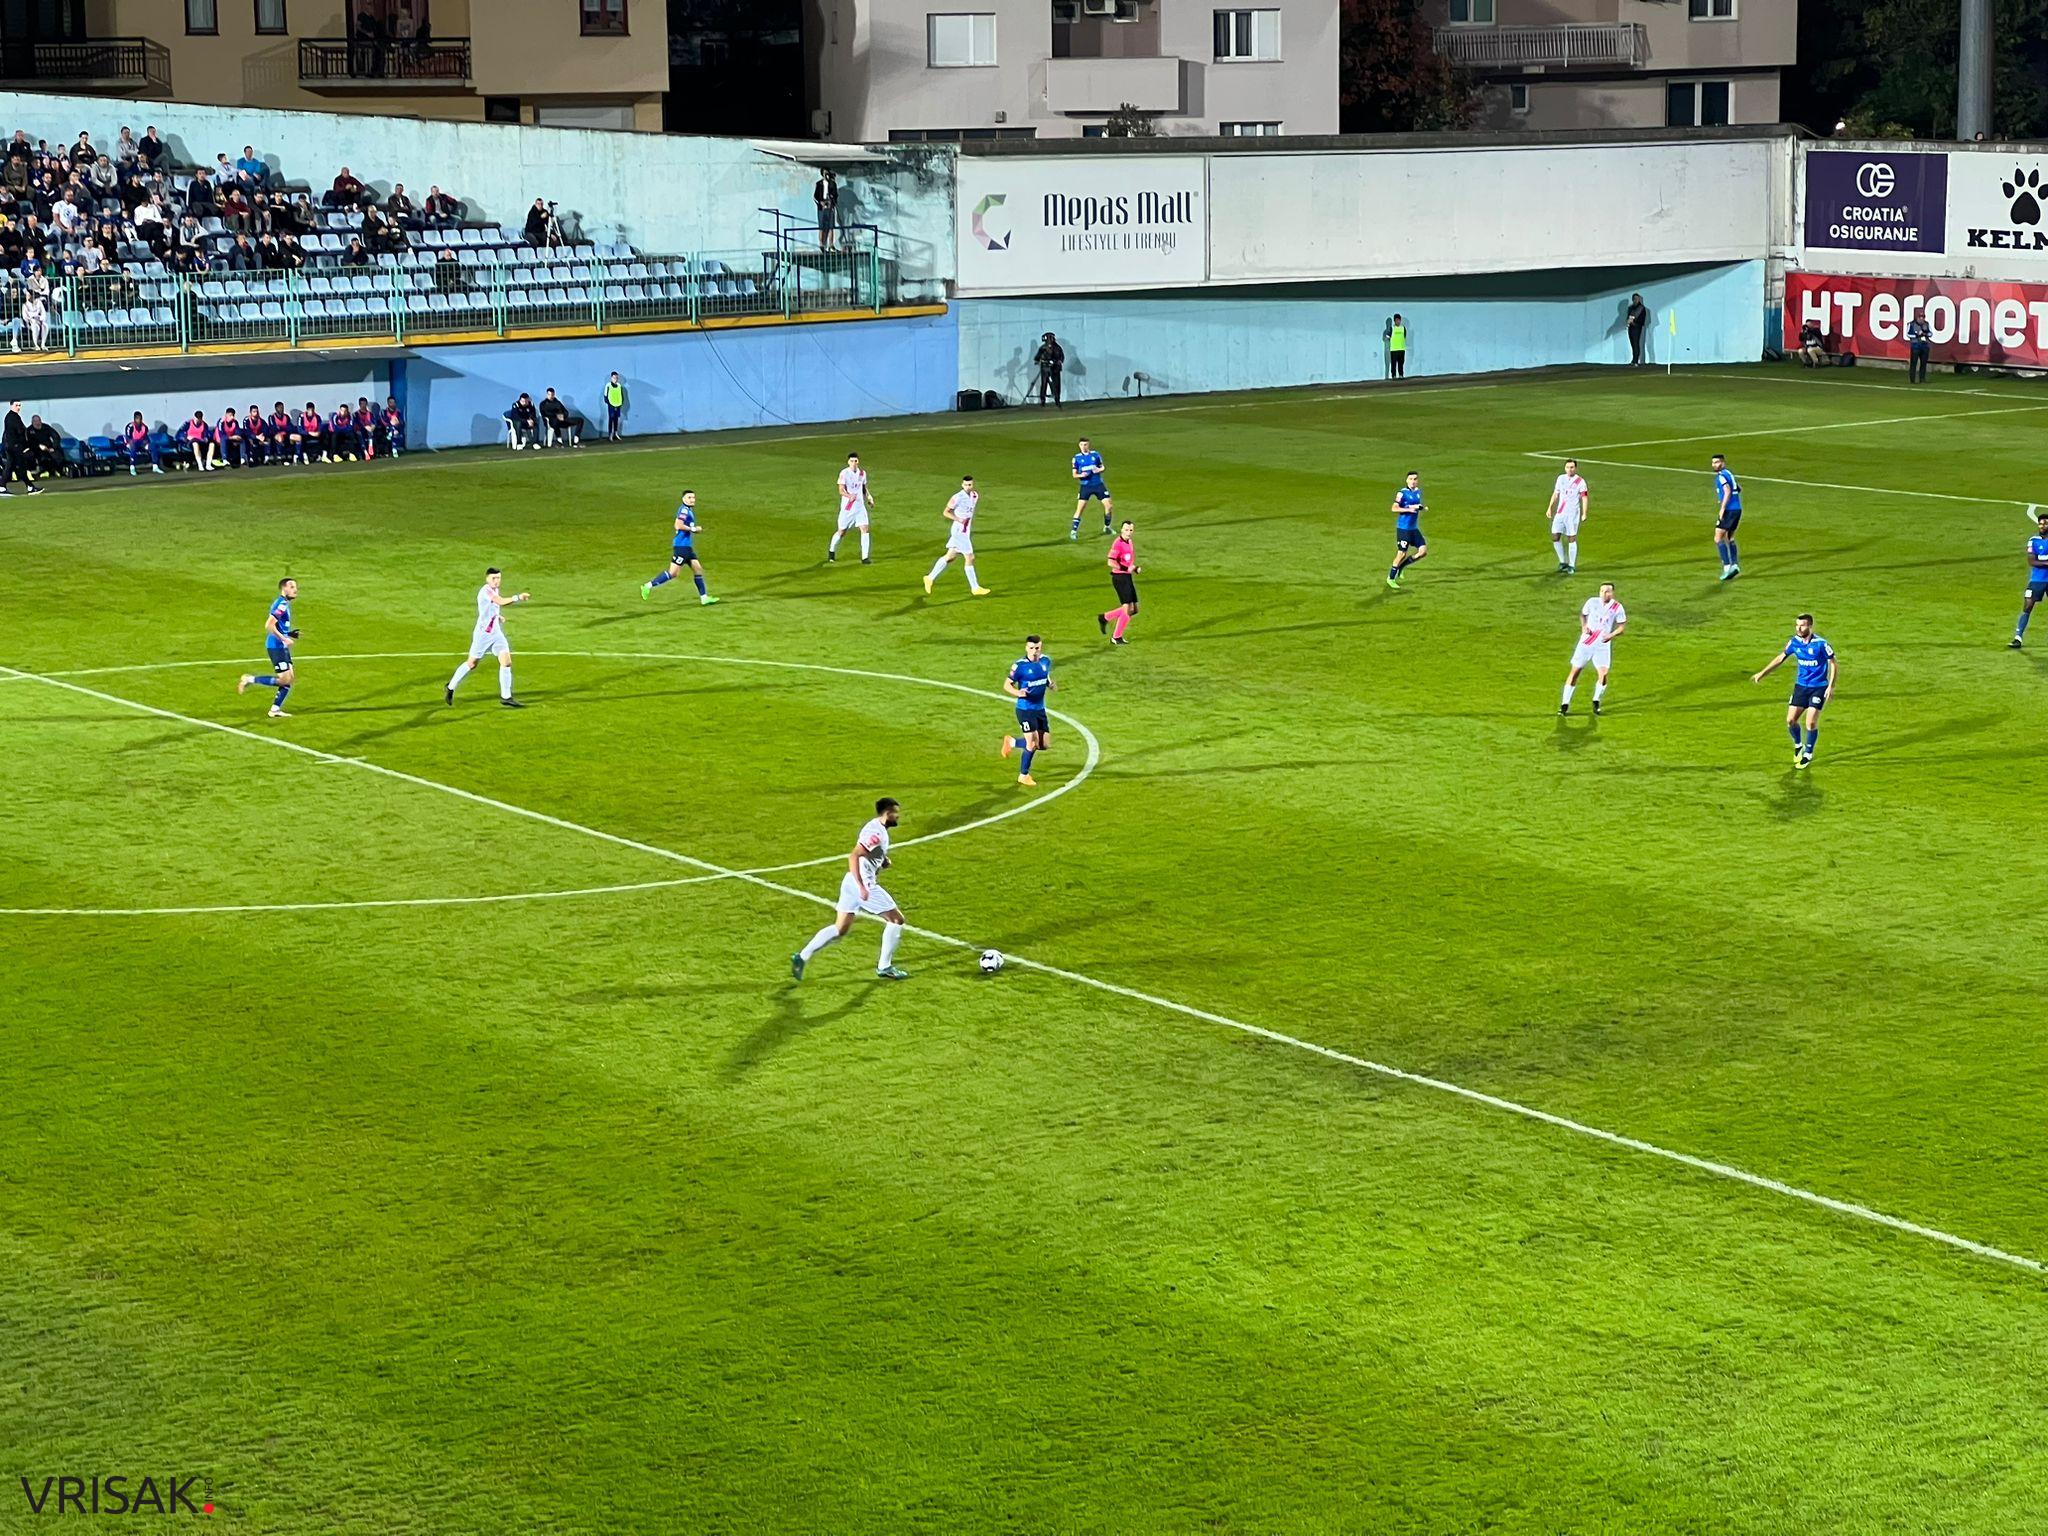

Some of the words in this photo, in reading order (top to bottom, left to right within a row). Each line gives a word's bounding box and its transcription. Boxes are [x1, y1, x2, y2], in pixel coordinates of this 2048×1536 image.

[1044, 193, 1129, 230] Mepas
[1137, 191, 1192, 224] Mall
[1842, 206, 1904, 222] CROATIA
[1829, 224, 1918, 241] OSIGURANJE
[1802, 290, 1862, 338] HT
